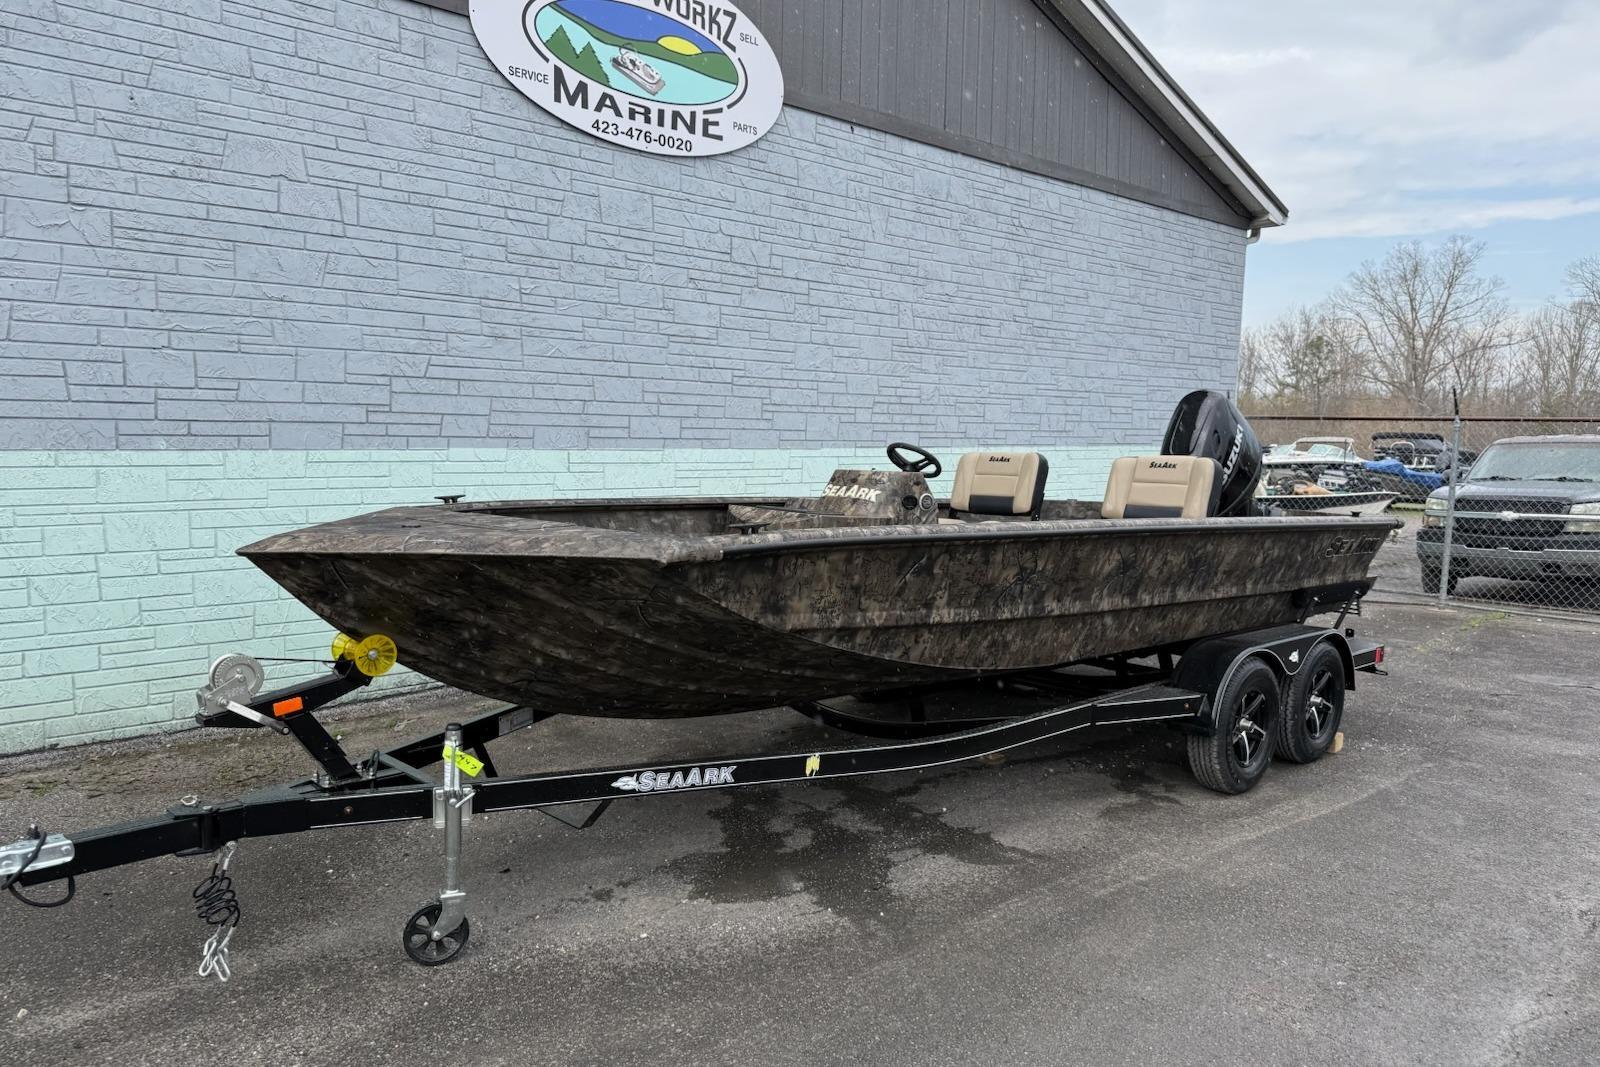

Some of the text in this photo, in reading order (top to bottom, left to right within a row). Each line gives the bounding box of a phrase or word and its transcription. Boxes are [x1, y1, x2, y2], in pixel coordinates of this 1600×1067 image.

[739, 32, 759, 47] SELL
[508, 65, 549, 85] SERVICE
[553, 64, 724, 142] MARINE
[591, 118, 693, 153] 423-476-0020
[732, 121, 758, 136] PARTS
[822, 483, 882, 503] SEAARK
[638, 765, 738, 792] SEAARK
